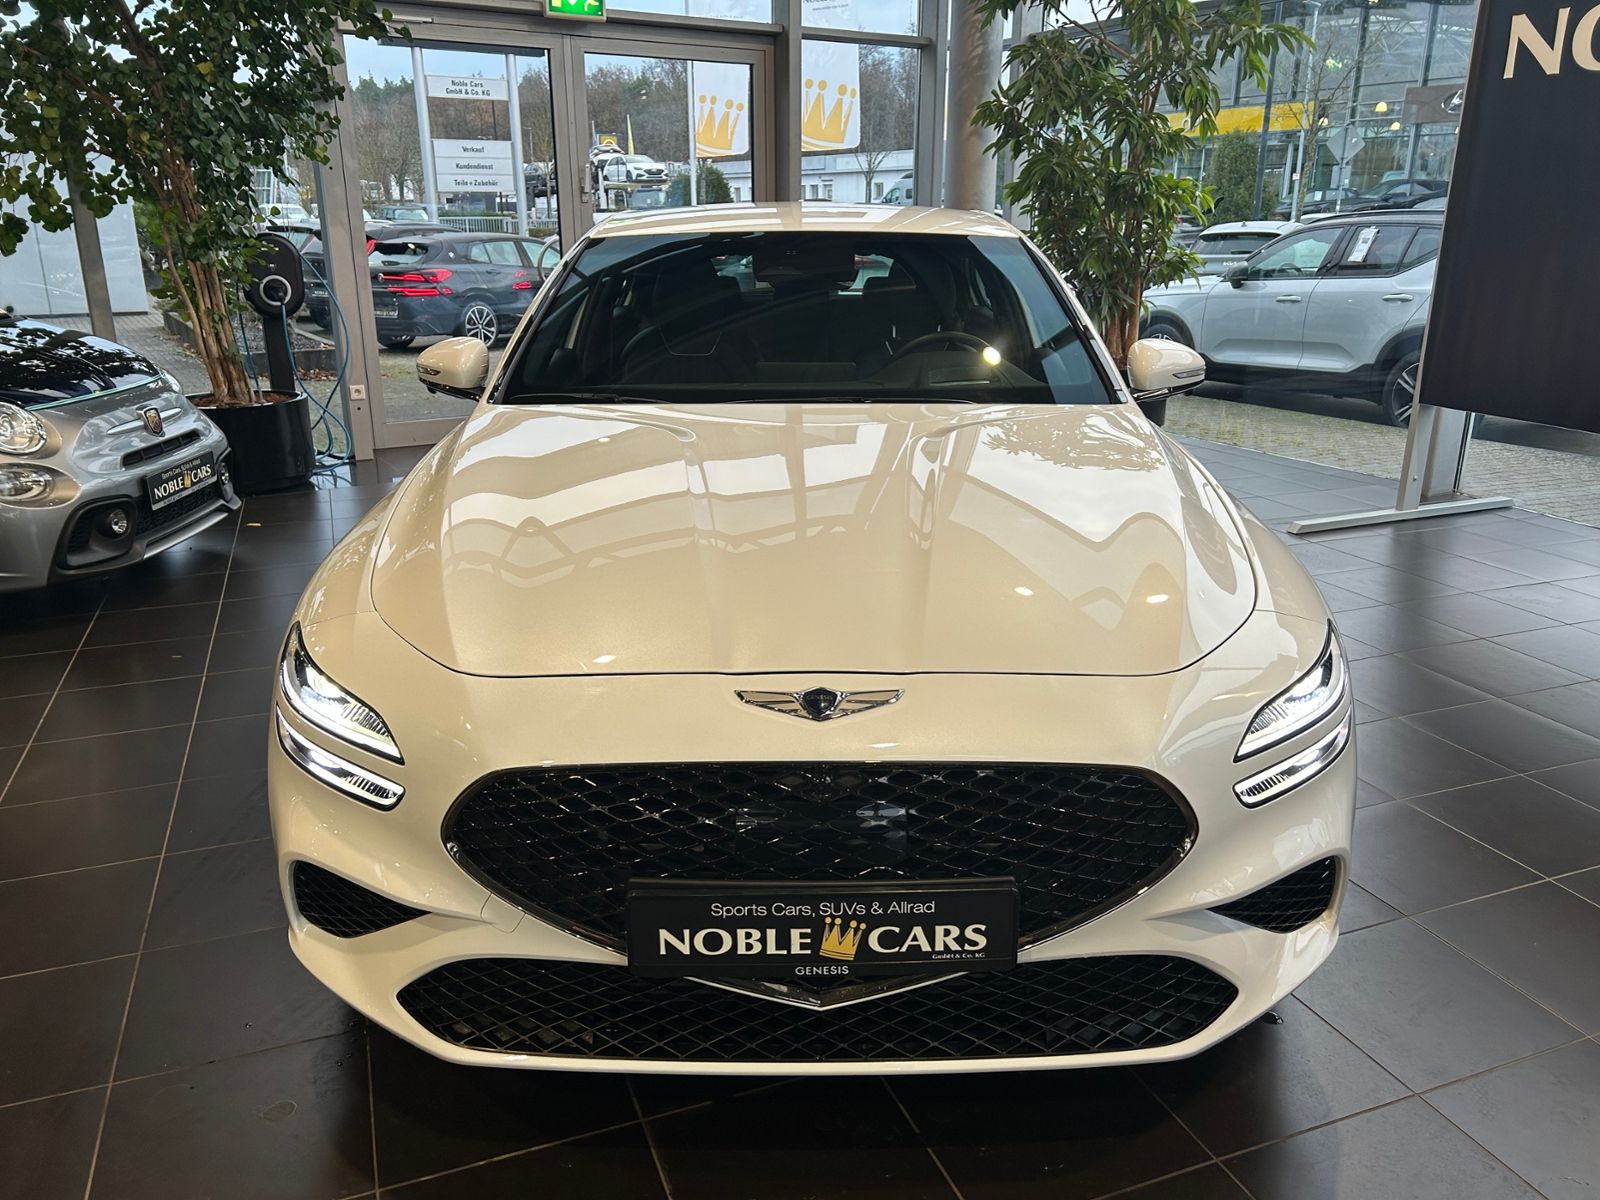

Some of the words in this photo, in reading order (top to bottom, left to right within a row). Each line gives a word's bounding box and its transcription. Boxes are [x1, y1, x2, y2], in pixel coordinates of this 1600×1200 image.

[470, 80, 484, 88] Cars
[445, 87, 463, 95] GmbH
[470, 88, 480, 96] Co.
[482, 89, 491, 97] KG
[455, 162, 494, 170] Kundendienst
[154, 476, 184, 500] NOBLE
[191, 464, 212, 482] CARS
[711, 902, 767, 919] Sports
[771, 902, 816, 918] Cars,
[819, 902, 866, 916] SUVs
[870, 901, 883, 915] &
[887, 900, 935, 914] Allrad
[658, 928, 812, 956] NOBLE
[867, 923, 988, 954] CARS
[794, 965, 850, 976] GENESIS
